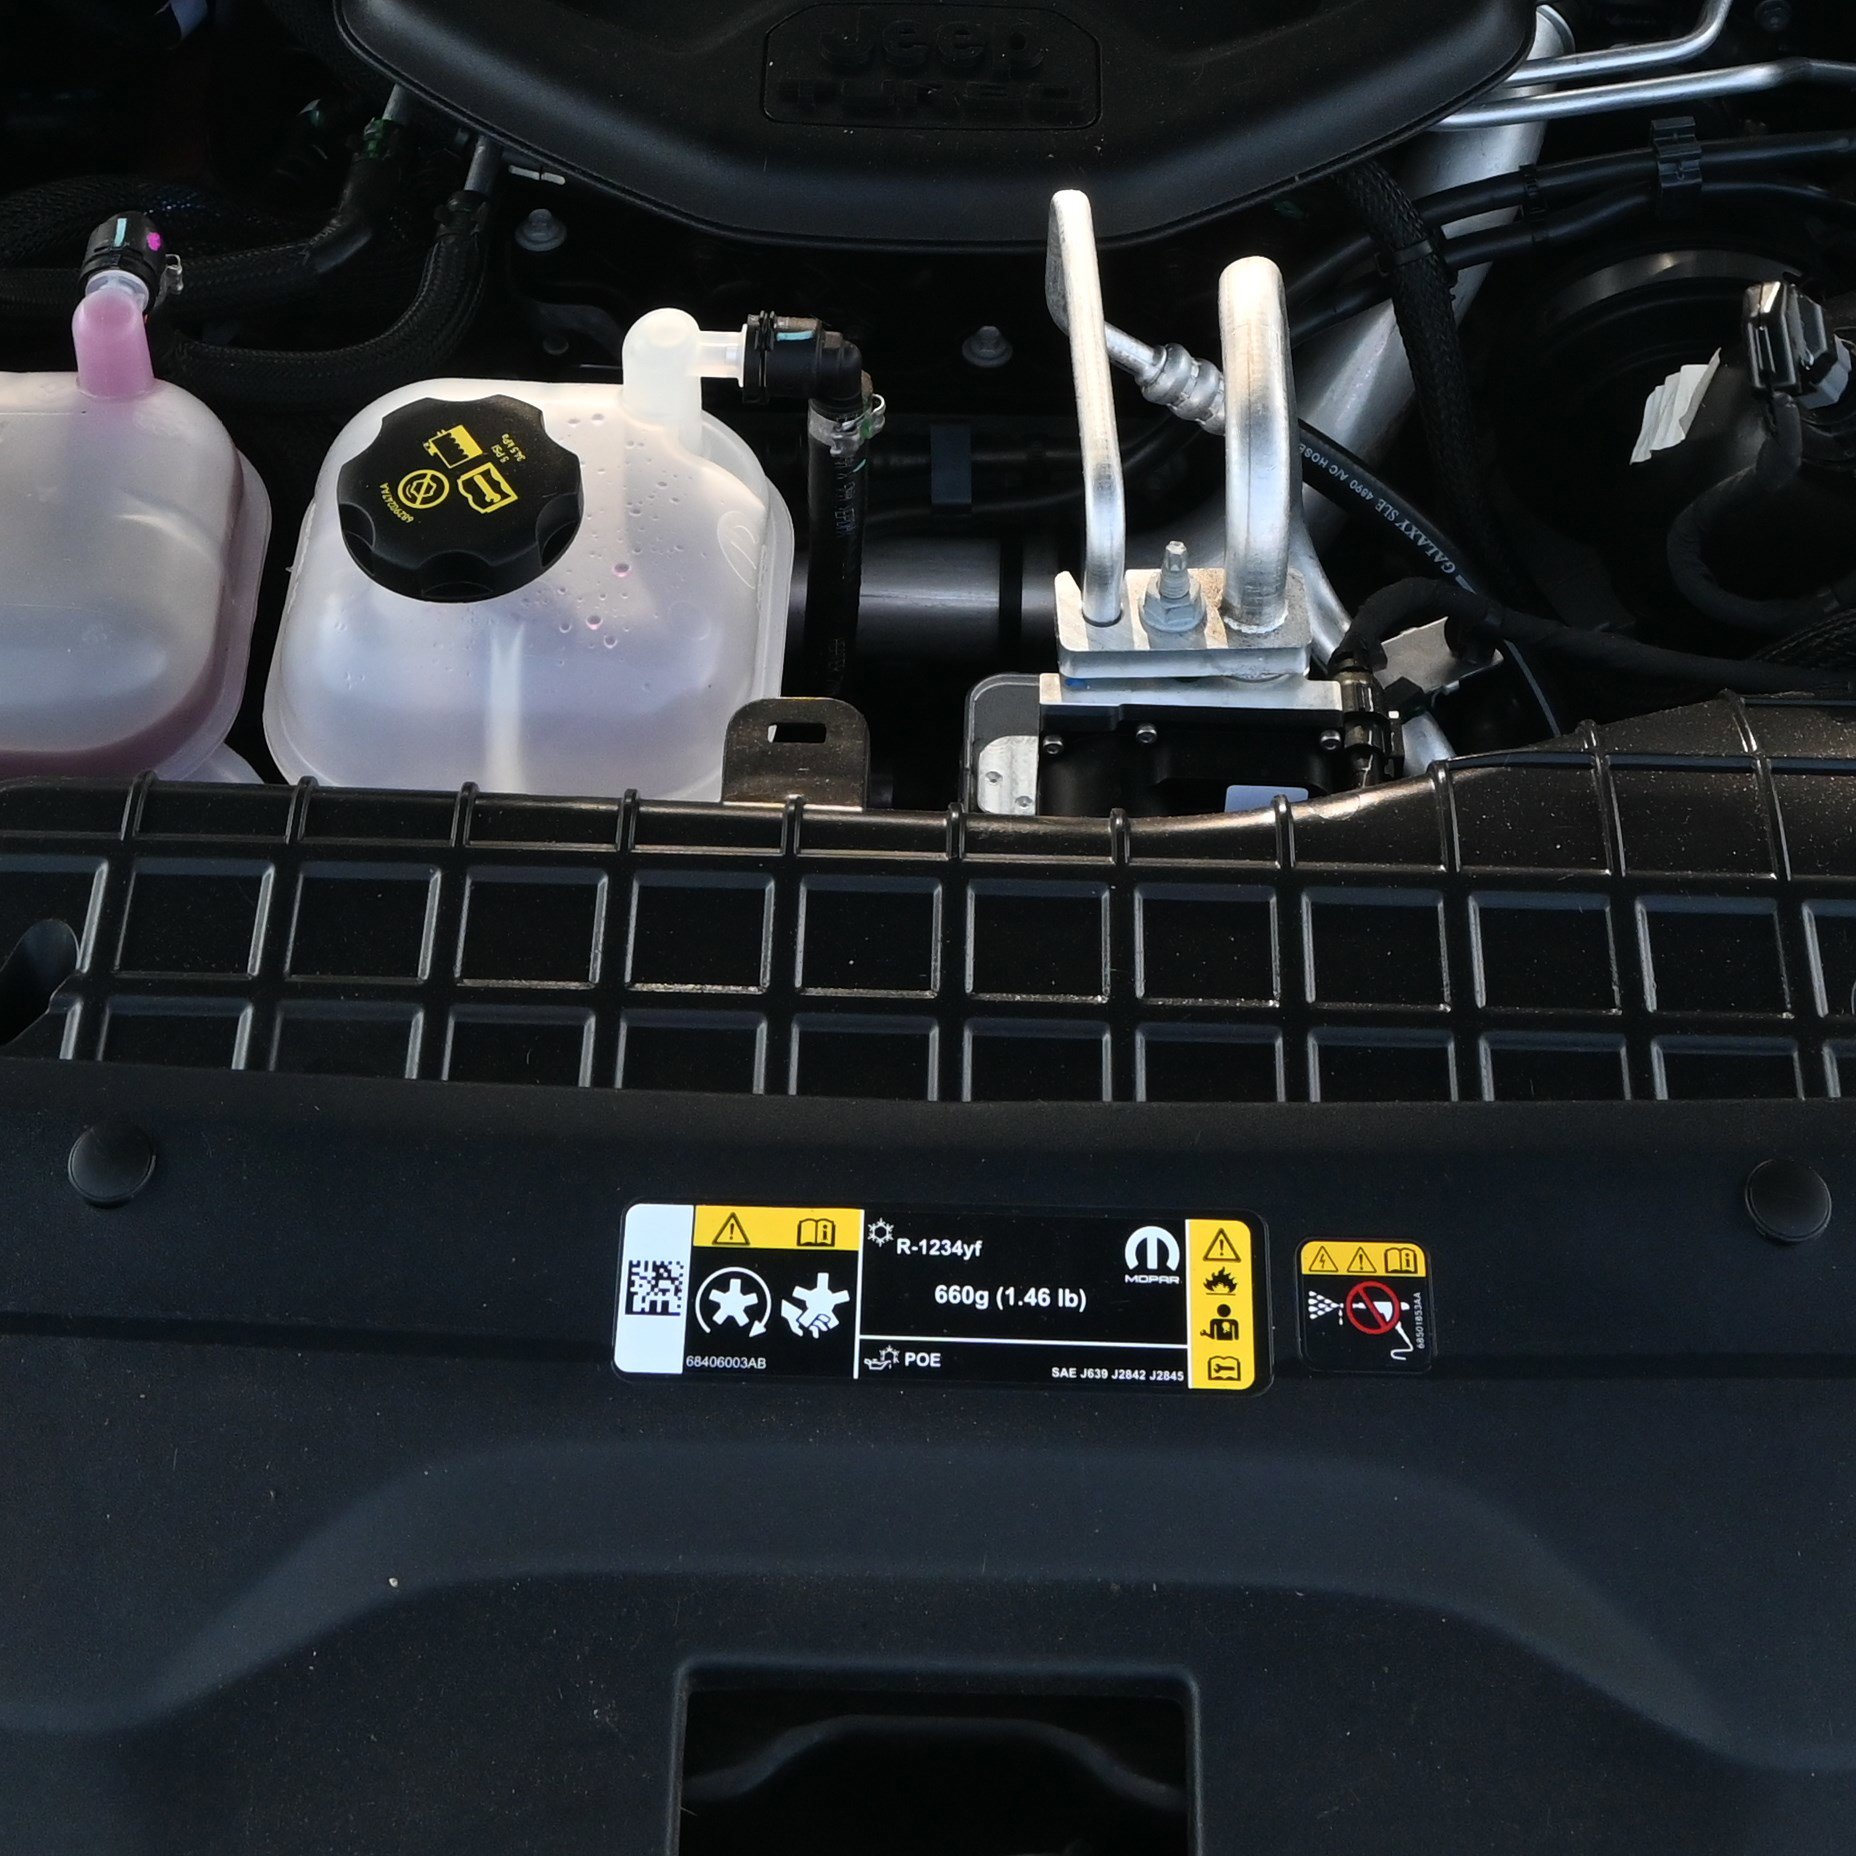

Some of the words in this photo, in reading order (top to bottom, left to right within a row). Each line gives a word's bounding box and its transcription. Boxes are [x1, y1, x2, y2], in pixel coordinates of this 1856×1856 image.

[1328, 464, 1349, 482] A/C
[1349, 479, 1375, 501] 4890
[1374, 498, 1399, 522] SLE
[1395, 518, 1456, 574] GALAXY
[896, 1237, 983, 1261] R-1234yf
[1123, 1273, 1181, 1285] MOPAR
[934, 1284, 990, 1311] 660g
[995, 1285, 1051, 1311] (1.46
[1058, 1287, 1087, 1313] lb)
[685, 1354, 768, 1370] 68406003AB
[904, 1351, 942, 1367] POE
[1051, 1367, 1077, 1378] SAE
[1080, 1368, 1109, 1379] J639
[1111, 1369, 1146, 1381] J2842
[1149, 1370, 1185, 1382] J2845
